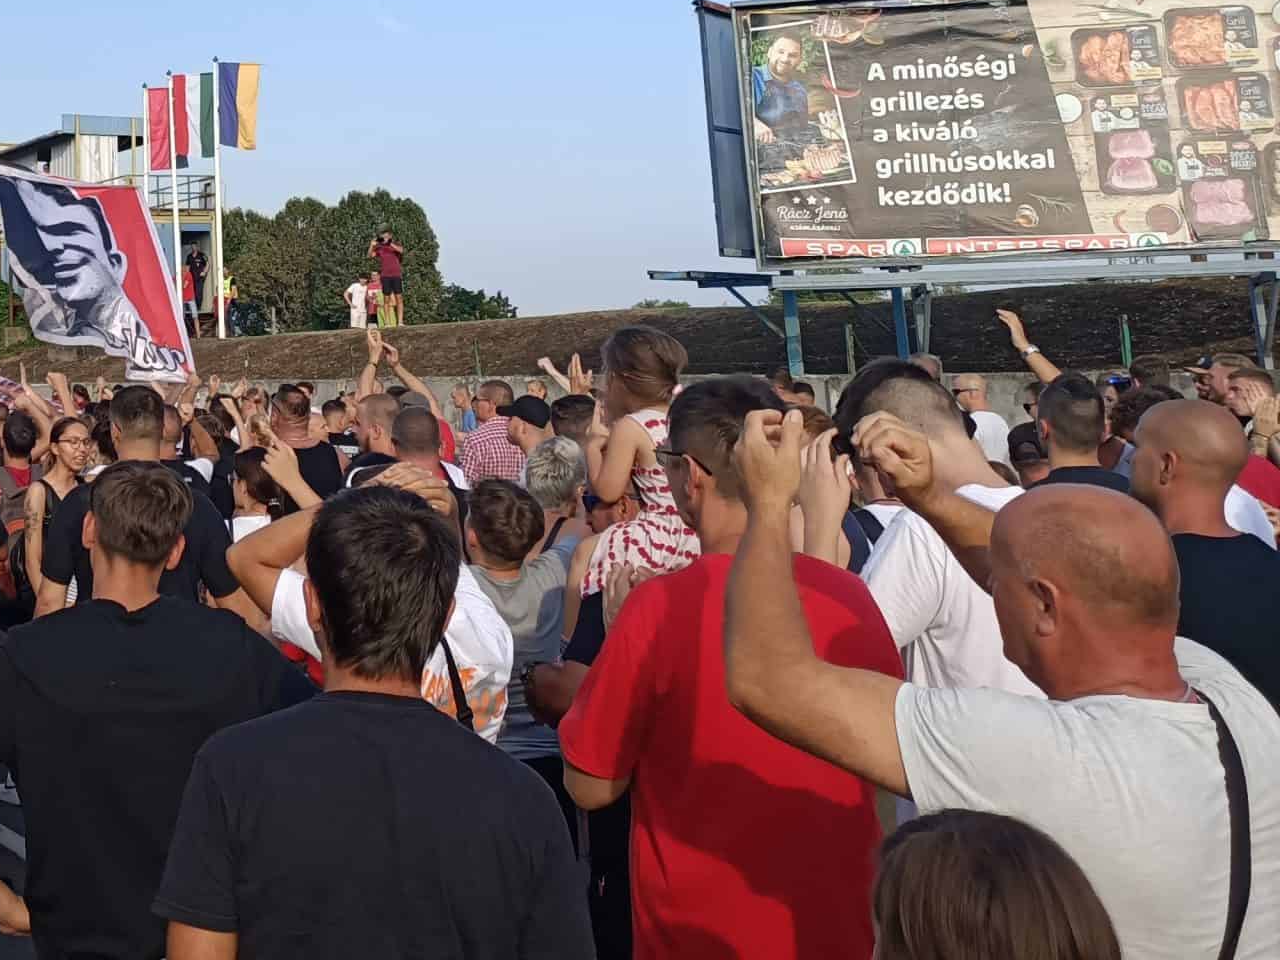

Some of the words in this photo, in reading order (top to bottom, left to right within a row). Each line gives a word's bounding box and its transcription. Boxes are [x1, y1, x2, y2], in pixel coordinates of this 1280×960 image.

[868, 62, 886, 81] A
[892, 54, 1016, 81] minőségi
[870, 88, 985, 117] grillezés
[873, 127, 889, 143] a
[895, 120, 978, 142] kiváló
[875, 148, 1056, 179] grillhúsokkal
[878, 182, 1012, 206] kezdődik!
[805, 242, 888, 257] SPAR
